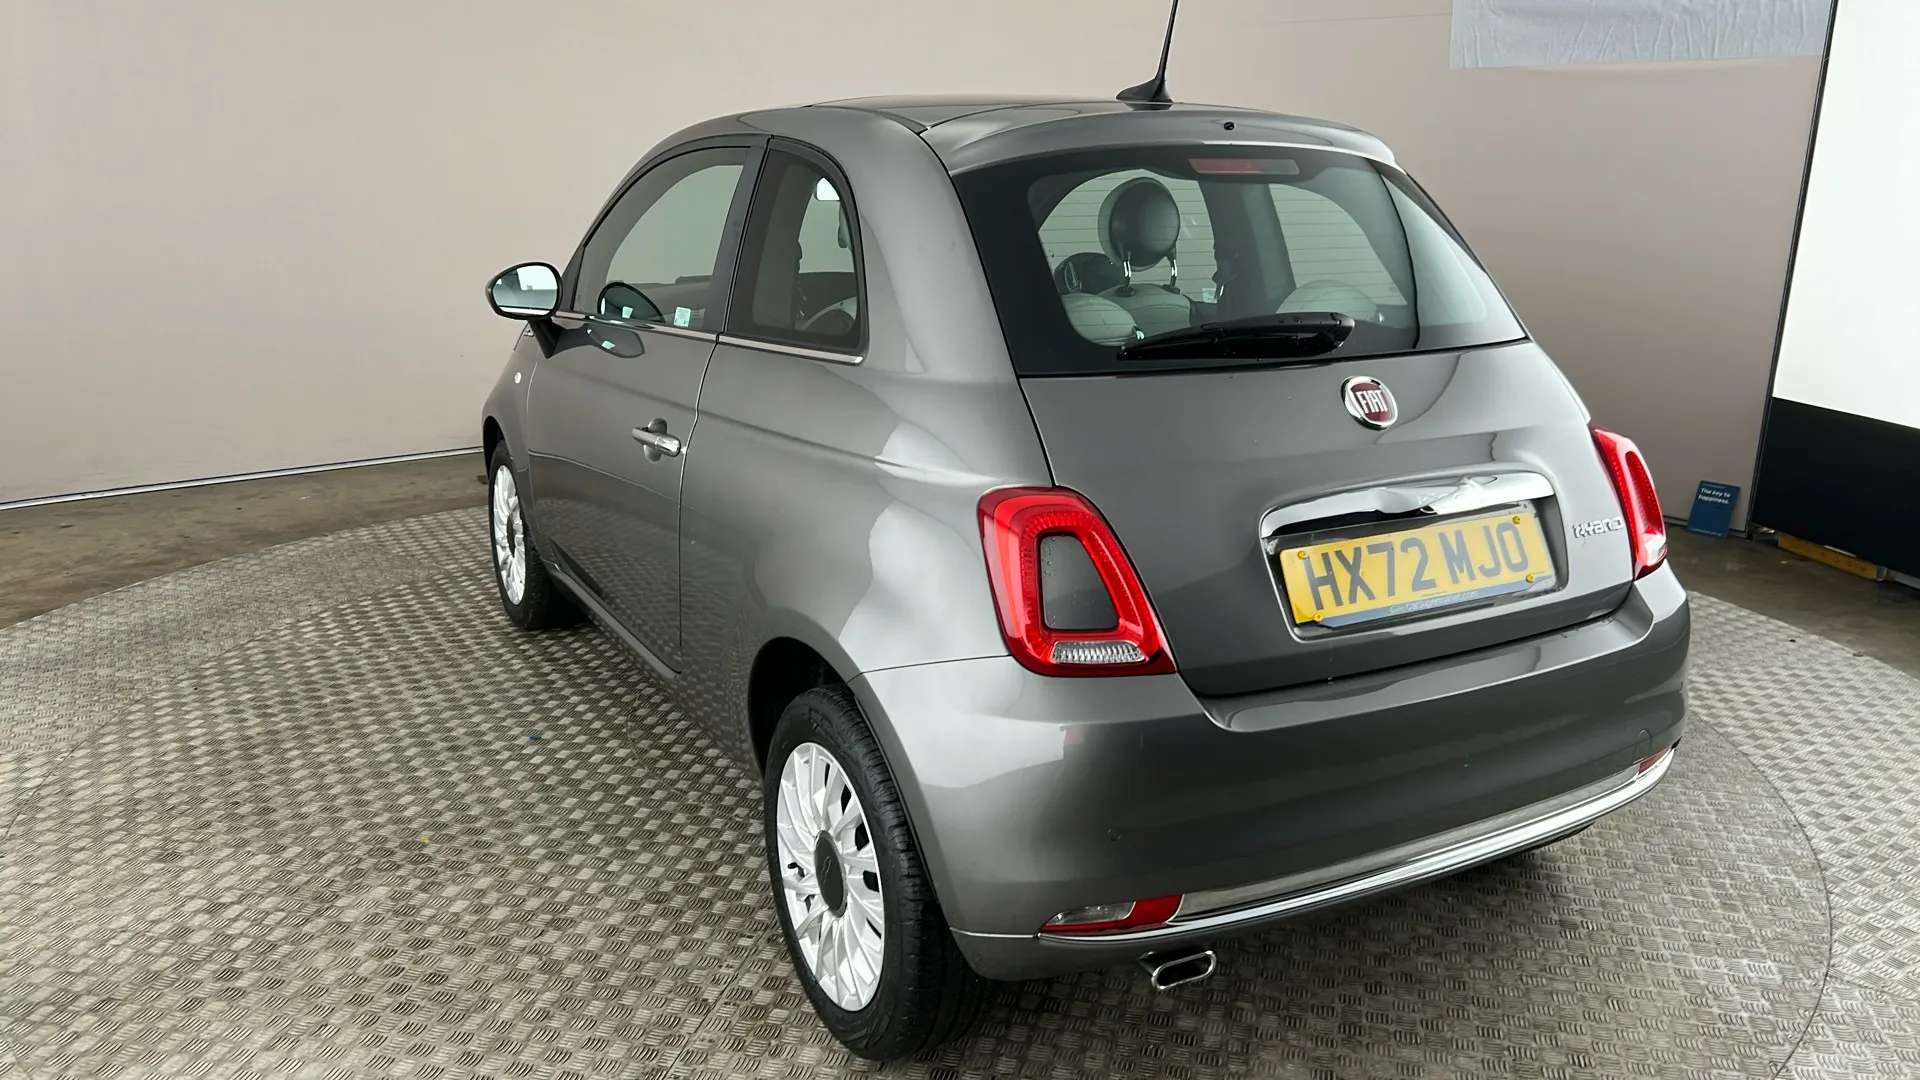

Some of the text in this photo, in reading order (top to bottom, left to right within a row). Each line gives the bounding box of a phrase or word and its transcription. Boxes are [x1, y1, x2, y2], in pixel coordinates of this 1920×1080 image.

[1355, 389, 1389, 414] FIAT
[1303, 520, 1530, 611] HX72 MJO
